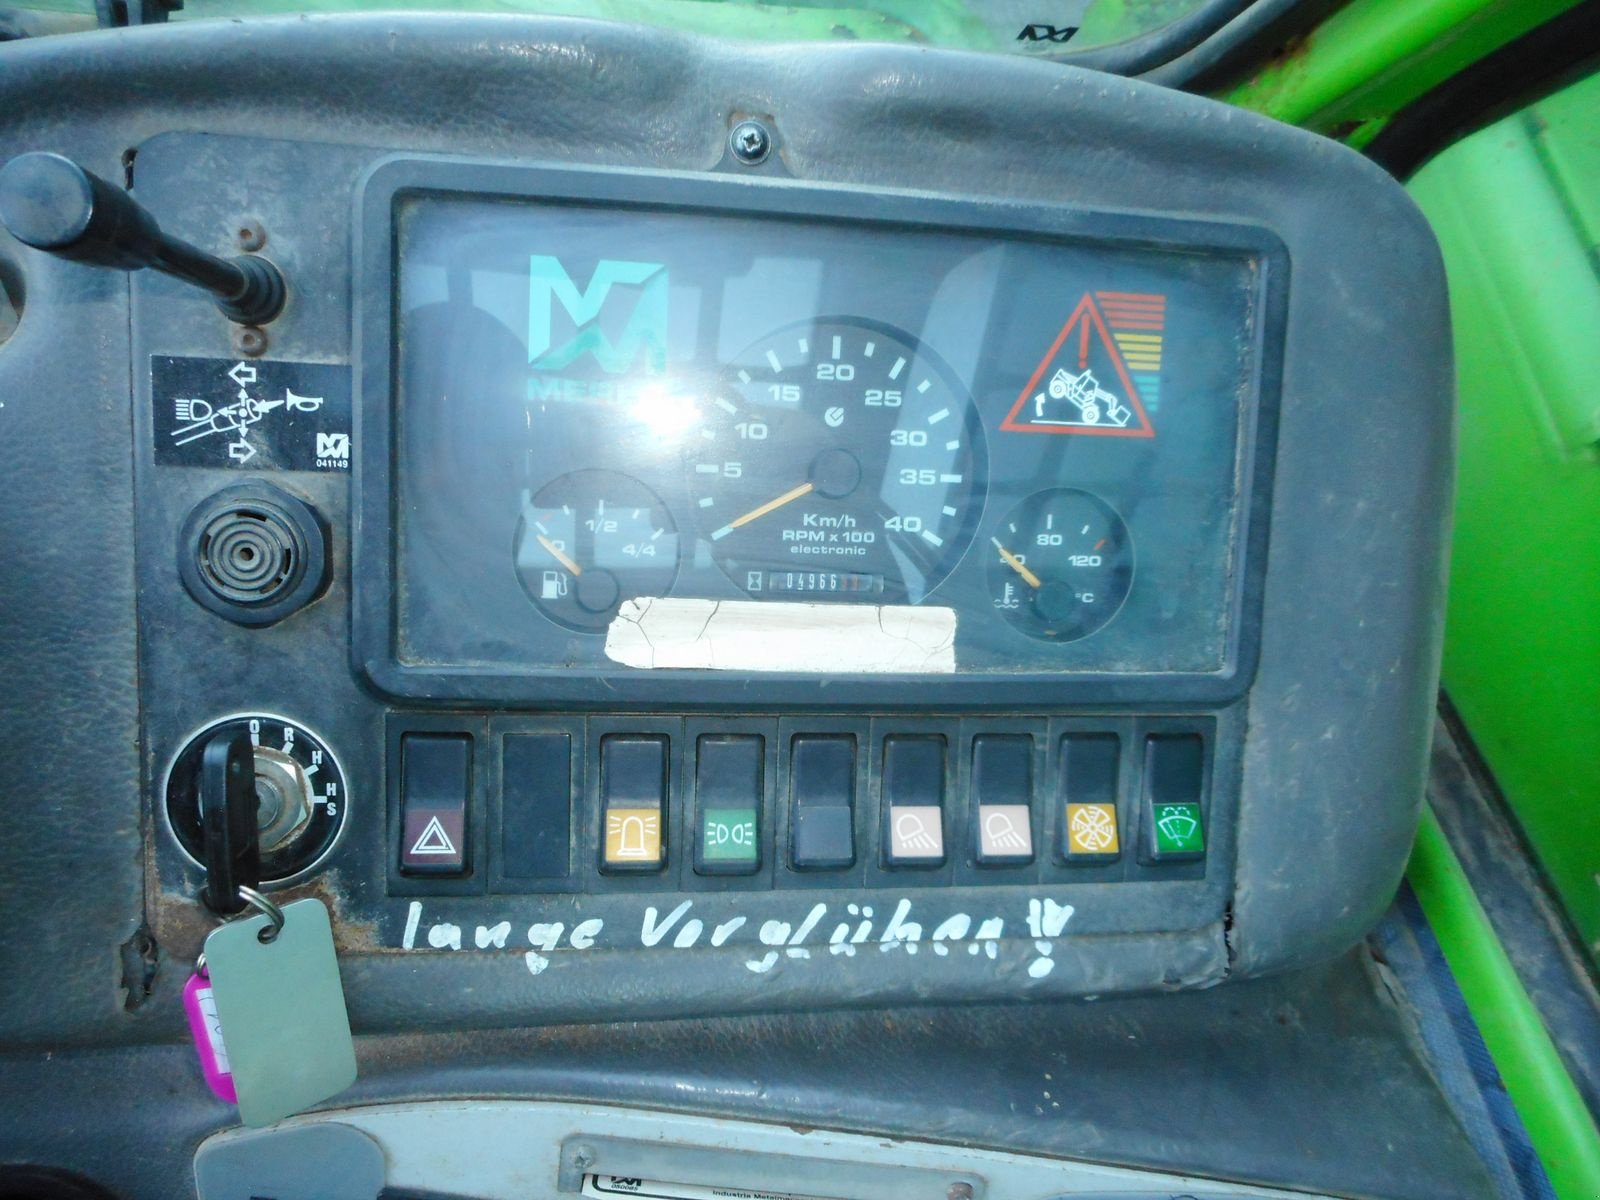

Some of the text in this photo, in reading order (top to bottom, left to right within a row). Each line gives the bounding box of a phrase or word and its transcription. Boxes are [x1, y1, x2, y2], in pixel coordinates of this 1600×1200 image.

[816, 363, 855, 381] 20
[768, 385, 801, 402] 15
[864, 390, 902, 407] 25
[735, 423, 768, 440] 10
[890, 430, 927, 447] 30
[315, 458, 349, 469] 041149
[723, 462, 742, 478] 5
[899, 469, 936, 486] 35
[584, 517, 618, 535] 1/2
[803, 513, 857, 529] Km/h
[884, 516, 922, 533] 40
[782, 529, 825, 542] RPM
[842, 531, 876, 543] 100
[1036, 534, 1063, 546] 80
[621, 542, 657, 558] 4/4
[790, 543, 867, 556] electronic
[1067, 555, 1102, 567] 120
[284, 727, 295, 742] R
[311, 750, 323, 765] H
[326, 782, 337, 797] H
[326, 802, 337, 817] S
